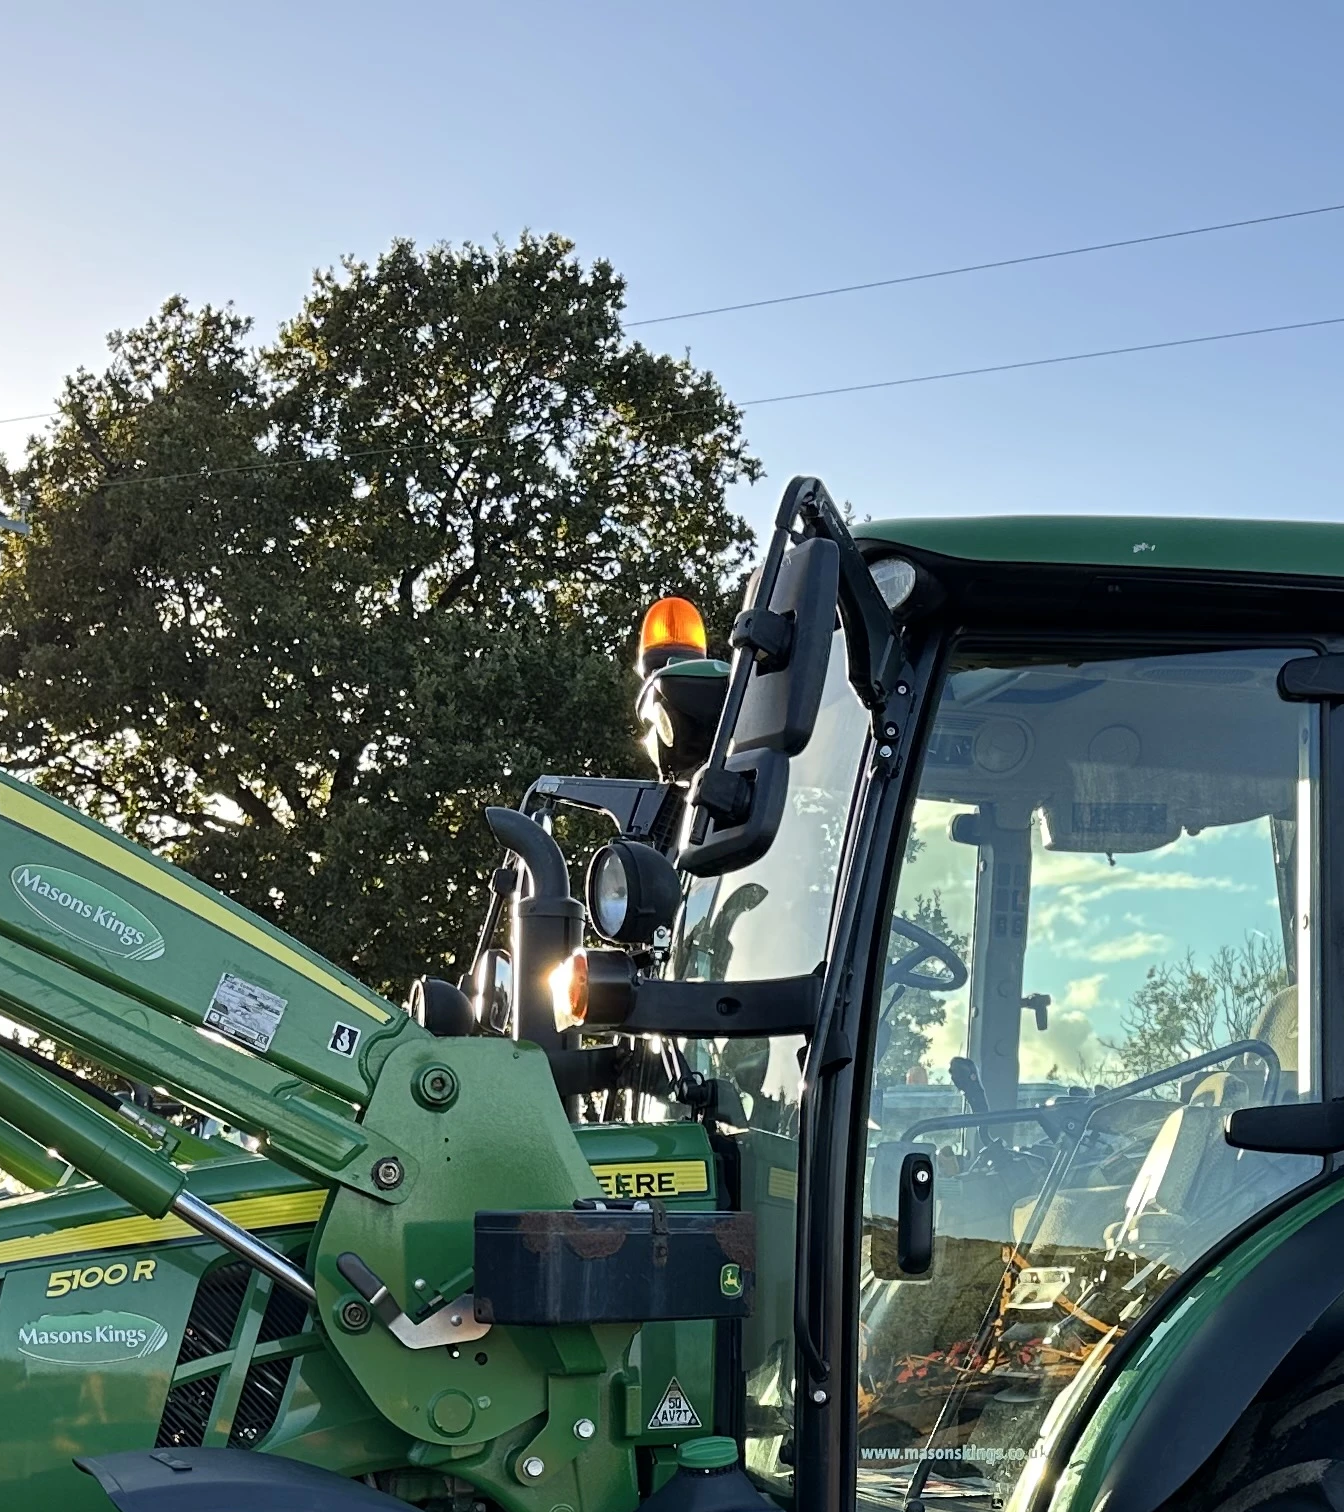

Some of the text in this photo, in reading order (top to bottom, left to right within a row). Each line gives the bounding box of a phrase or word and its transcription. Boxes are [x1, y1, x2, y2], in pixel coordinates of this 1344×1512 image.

[17, 868, 146, 946] Masons Kings
[46, 1259, 157, 1298] 5100 R
[18, 1324, 147, 1348] Masons Kings
[860, 1444, 1047, 1466] www.masonskings.co.uk
